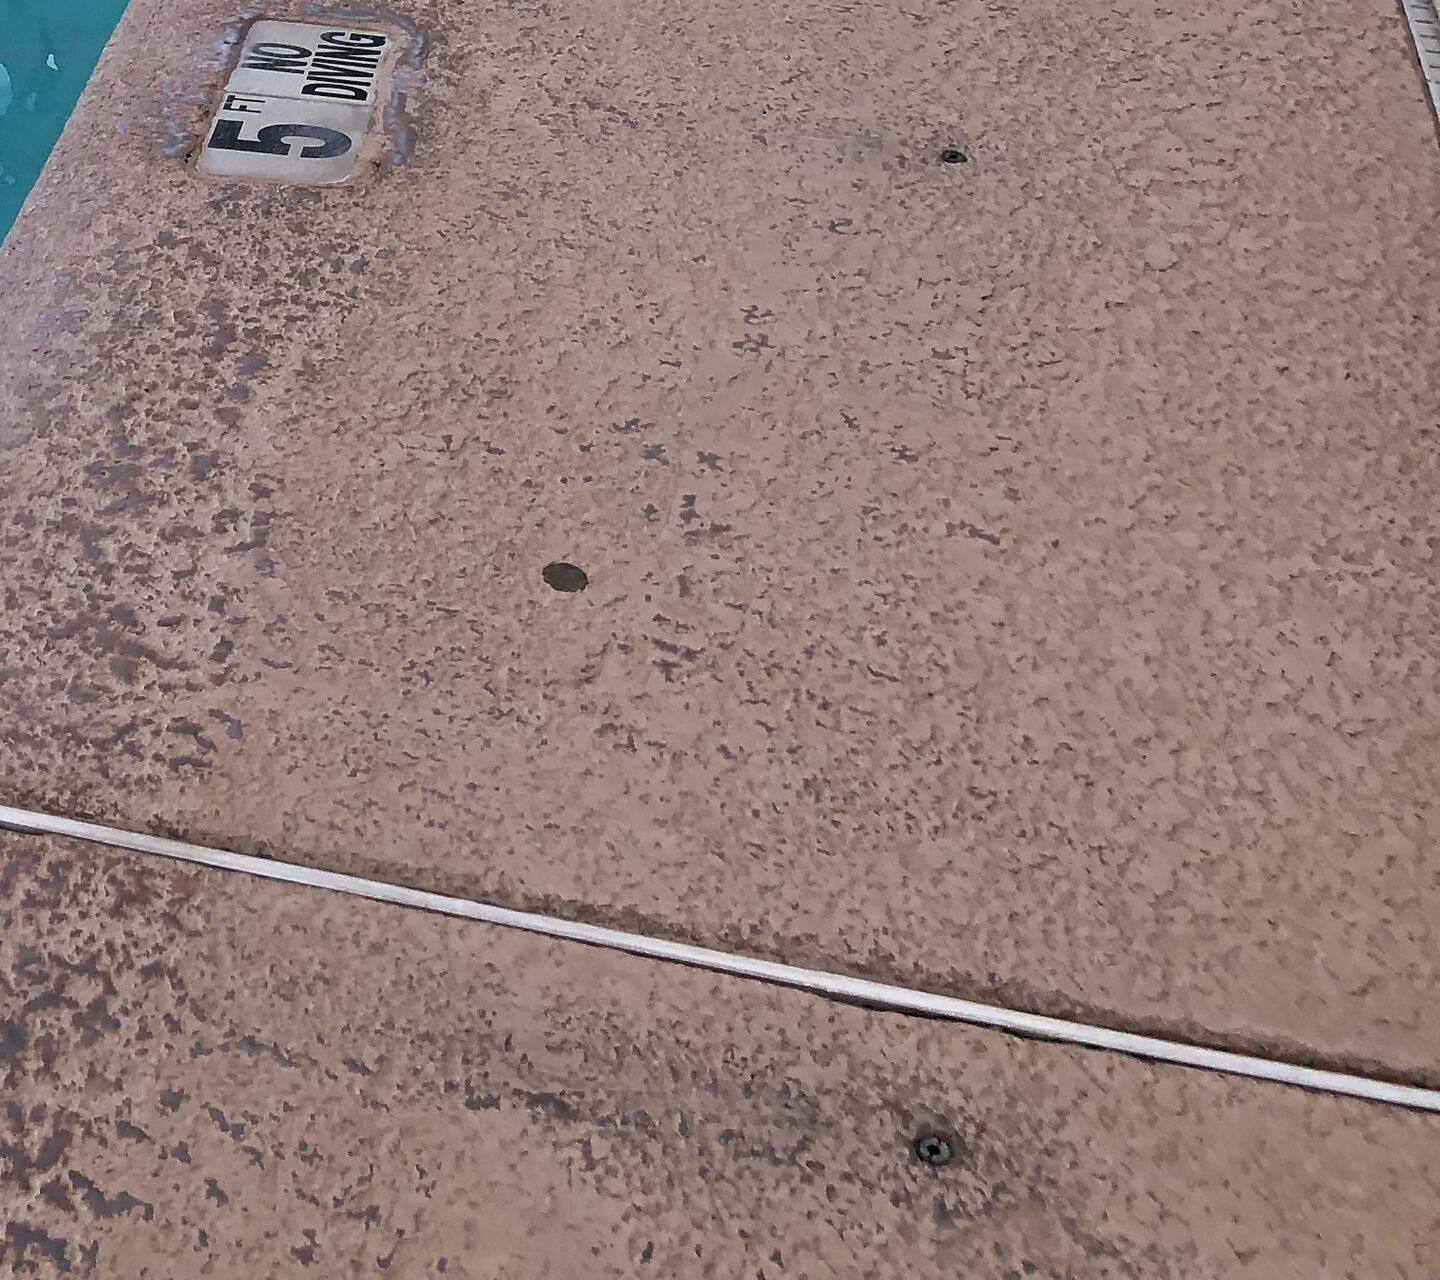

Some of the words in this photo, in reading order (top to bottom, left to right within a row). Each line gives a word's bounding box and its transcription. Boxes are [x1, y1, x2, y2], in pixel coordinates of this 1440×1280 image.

[240, 41, 313, 75] NO
[300, 31, 387, 102] DIVING
[222, 93, 266, 115] FT
[207, 118, 353, 160] 5
